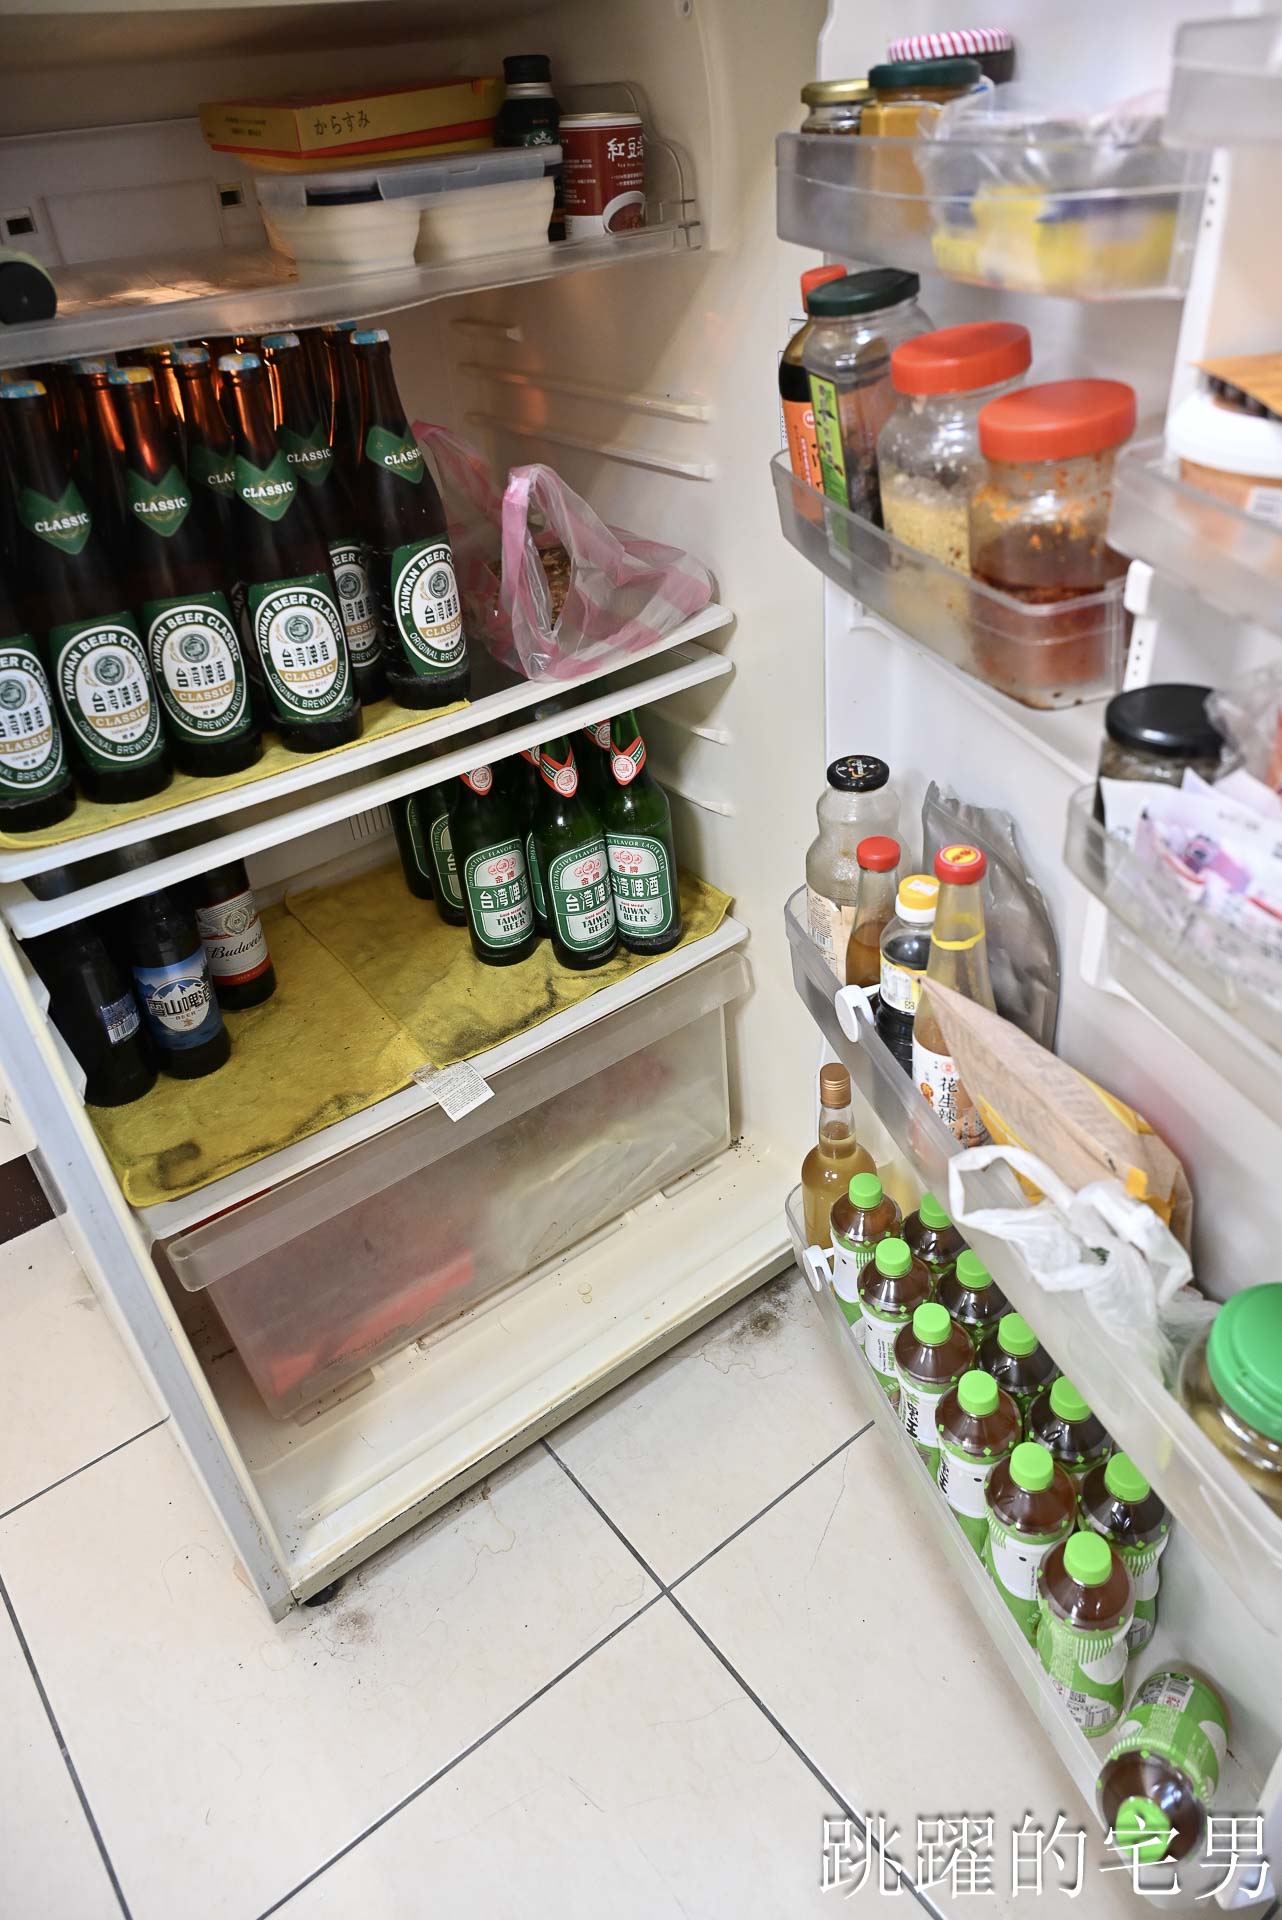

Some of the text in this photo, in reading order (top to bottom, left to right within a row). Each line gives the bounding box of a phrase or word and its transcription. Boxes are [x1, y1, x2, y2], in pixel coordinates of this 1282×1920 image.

[313, 109, 371, 136] からすみ
[286, 448, 332, 464] CLASSIC
[242, 481, 294, 499] CLASSIC
[133, 496, 187, 514] CLASSIC
[34, 511, 89, 534] CLASSIC
[401, 550, 447, 617] TAIWAN BEER
[259, 593, 342, 655] TAIWAN BEER CLASSIC
[152, 612, 241, 673] TAIWAN BEER CLASSIC
[409, 632, 438, 661] ORIGINAL
[63, 650, 83, 700] TAIWAN
[78, 632, 118, 652] BEER
[283, 663, 334, 681] CLASSIC
[179, 684, 231, 701] CLASSIC
[271, 673, 300, 706] ORIGINAL
[301, 689, 338, 709] BREWING
[95, 704, 149, 727] CLASSIC
[164, 692, 194, 727] ORIGINAL
[197, 710, 235, 730] BREWING
[78, 719, 113, 753] ORIGINAL
[116, 734, 153, 755] BREWING
[17, 753, 54, 782] BREWING
[613, 838, 639, 847] FLAVOR
[641, 840, 660, 855] LAGER
[468, 855, 486, 887] DISTINCTIVE
[554, 846, 598, 890] DISTINCTIVE FLAVOR
[495, 909, 527, 926] TAIWAN
[581, 909, 611, 929] TAIWAN
[619, 904, 650, 915] TAIWAN
[623, 912, 648, 922] BEER
[503, 917, 526, 933] BEER
[588, 918, 610, 935] BEER
[175, 1010, 196, 1020] BEER
[938, 1077, 958, 1131] 花生辣
